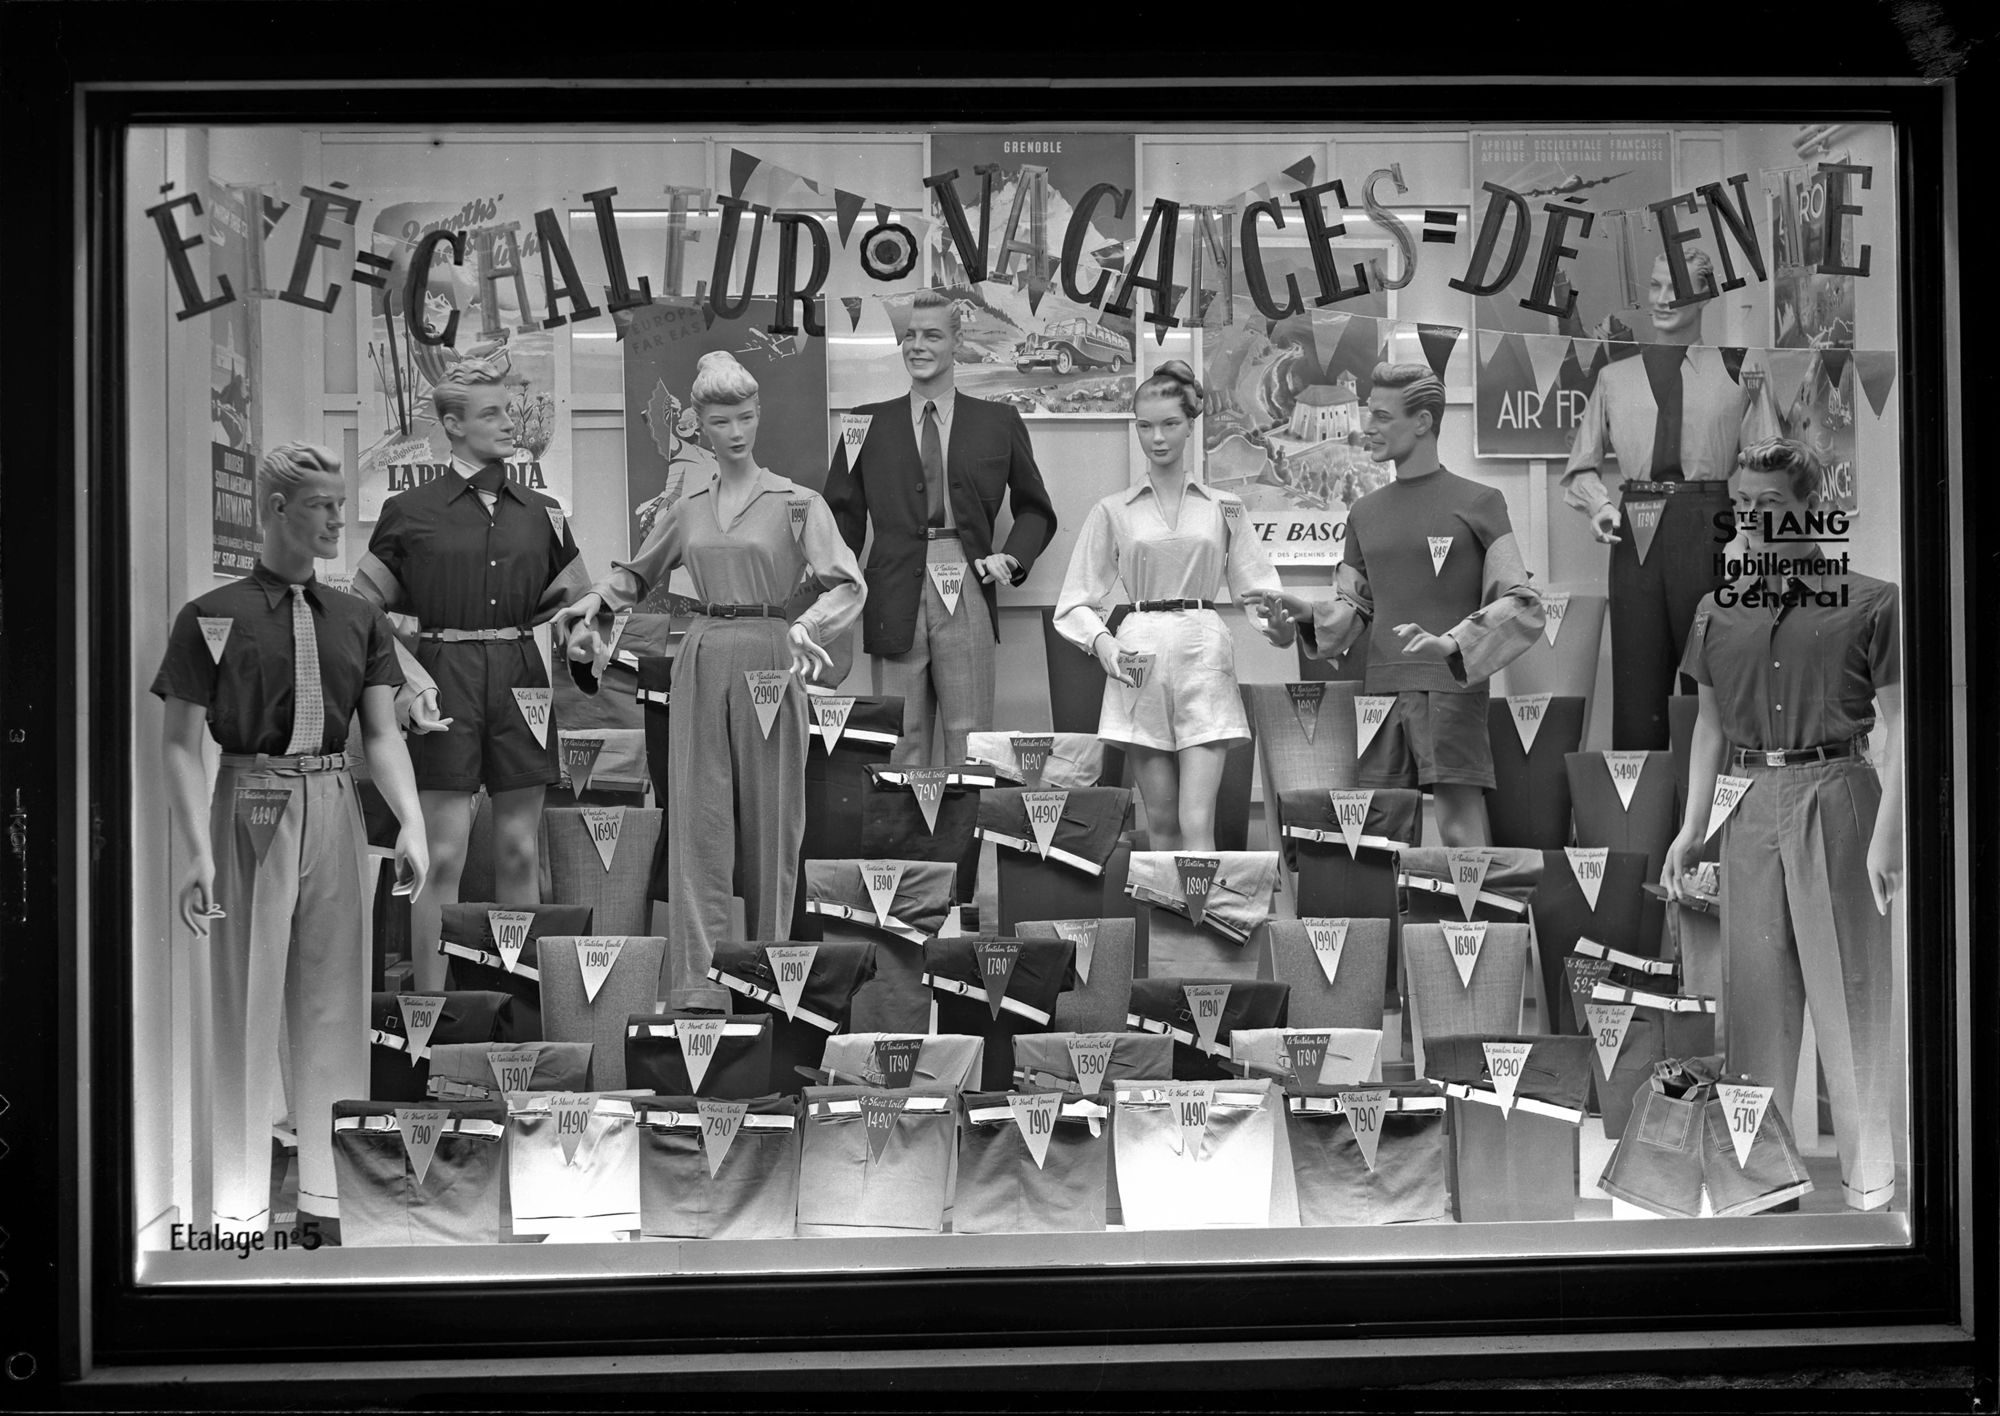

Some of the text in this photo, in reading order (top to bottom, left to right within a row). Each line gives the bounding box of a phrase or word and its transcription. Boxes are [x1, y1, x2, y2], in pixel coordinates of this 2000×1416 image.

[1004, 141, 1062, 153] GRENOBLE
[1481, 139, 1525, 150] AFRIQUE
[1534, 139, 1601, 150] OCCIDENTALE
[1481, 151, 1525, 162] AFRIQUE
[145, 181, 361, 322] ÉTÉ
[403, 184, 830, 348] CHALEUR
[923, 162, 1418, 328] VACANCES
[1448, 162, 1872, 319] DÉTENTE
[1497, 390, 1542, 428] AIR
[1764, 511, 1850, 542] LANG
[1713, 552, 1850, 577] Habillement
[170, 1223, 265, 1260] Etalage
